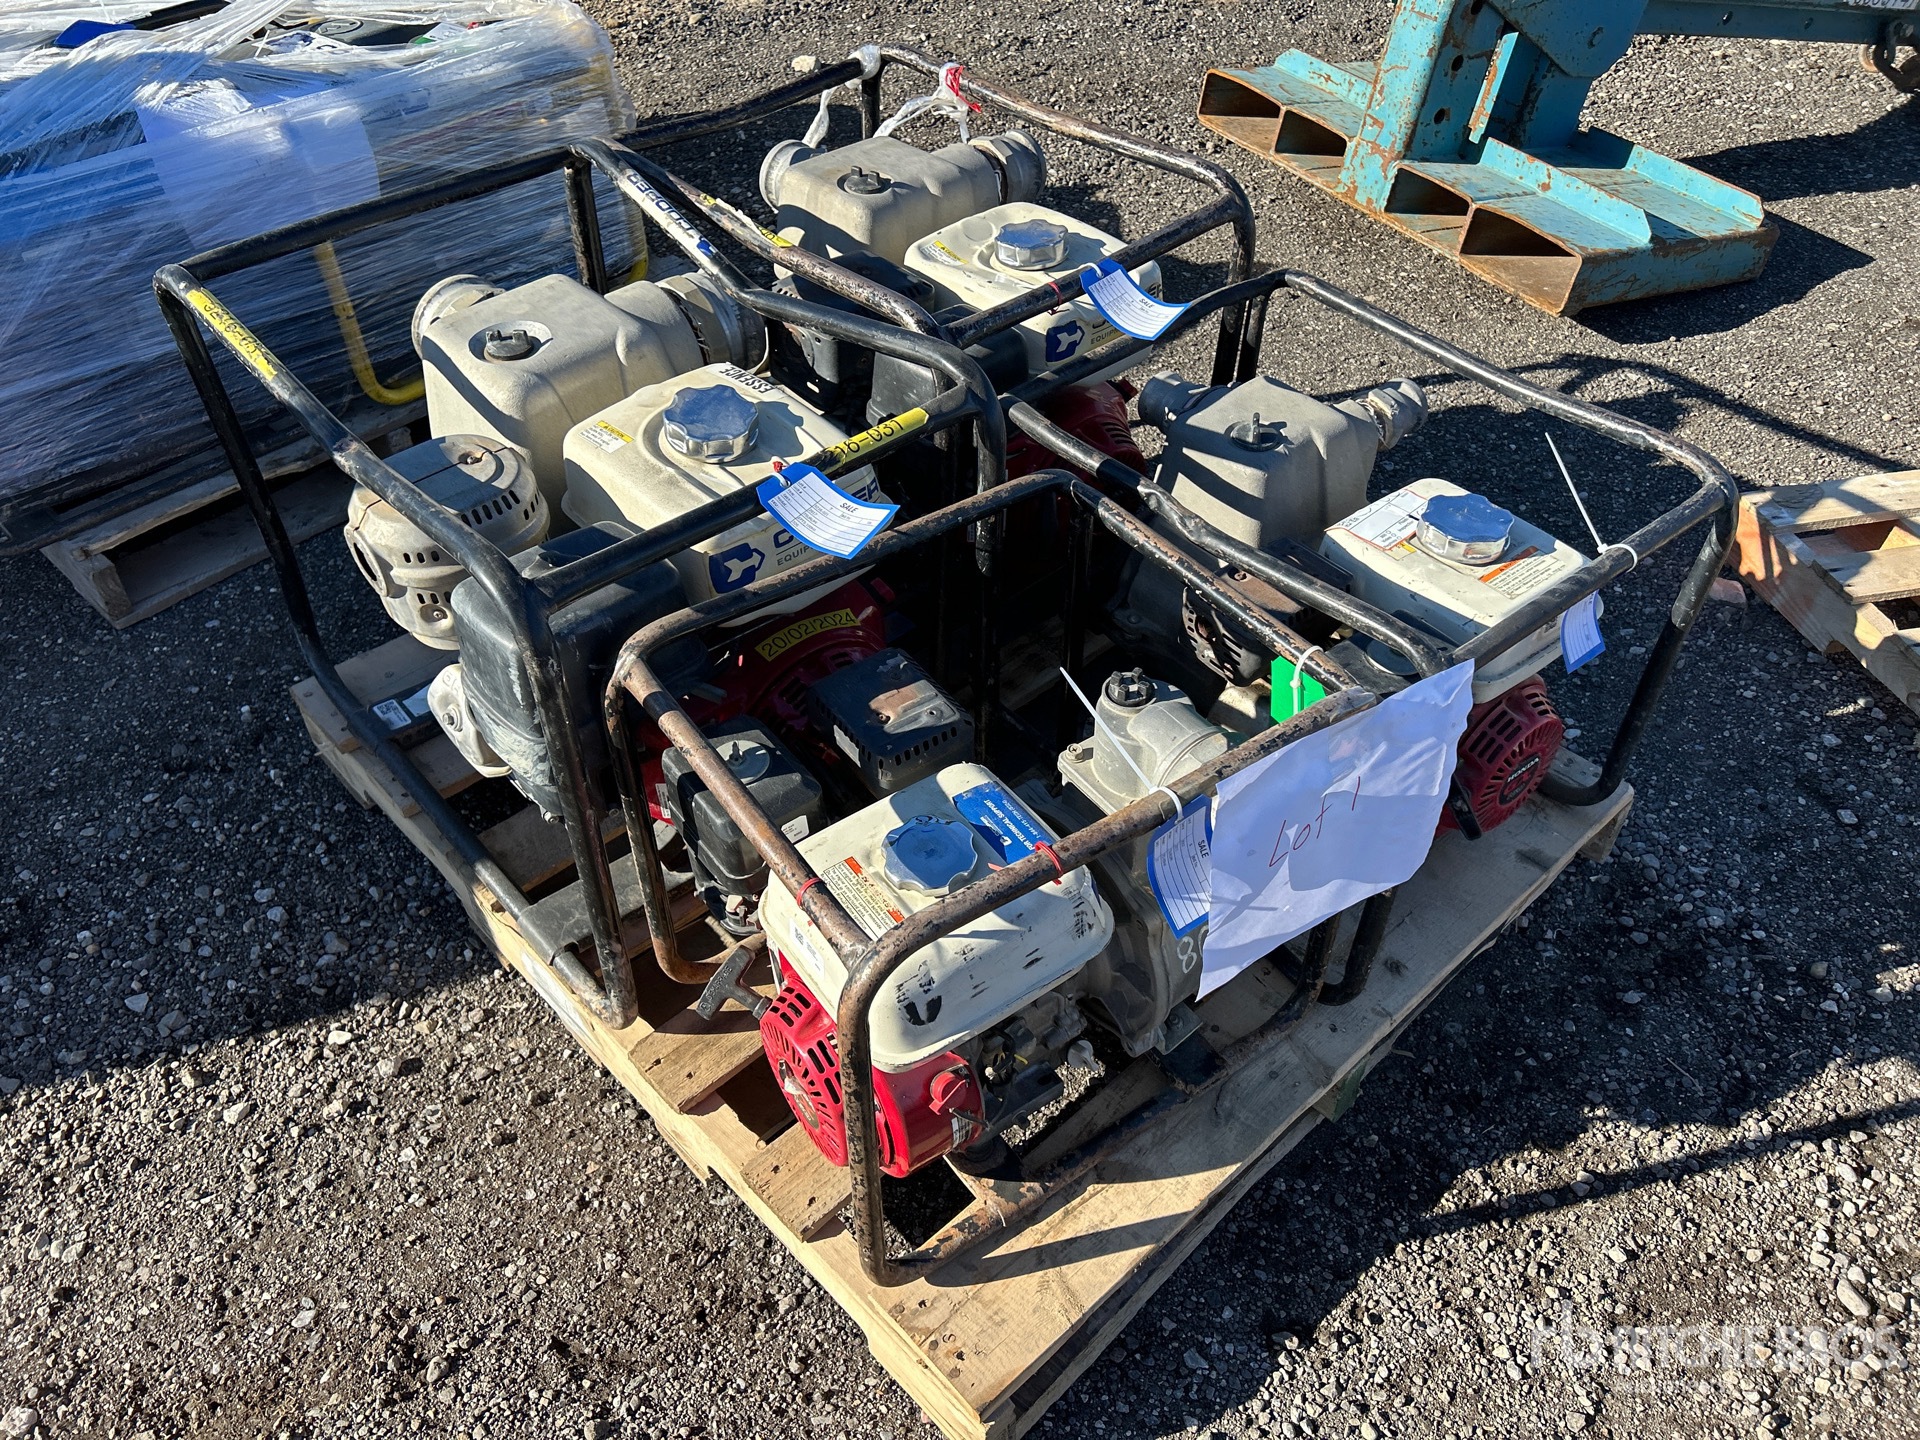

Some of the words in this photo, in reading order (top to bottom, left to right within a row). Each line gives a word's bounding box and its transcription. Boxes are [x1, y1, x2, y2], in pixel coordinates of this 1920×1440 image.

[1138, 298, 1154, 309] SALE
[719, 366, 775, 394] ESSENCE
[839, 502, 860, 514] SALE
[777, 546, 811, 566] EQUIP
[762, 612, 856, 658] 20/02/2024
[1507, 757, 1540, 783] HONDA
[984, 799, 1004, 818] SUPPORT
[1001, 816, 1026, 842] TECHNICAL
[1268, 794, 1334, 868] Lot
[1197, 839, 1210, 858] SALE
